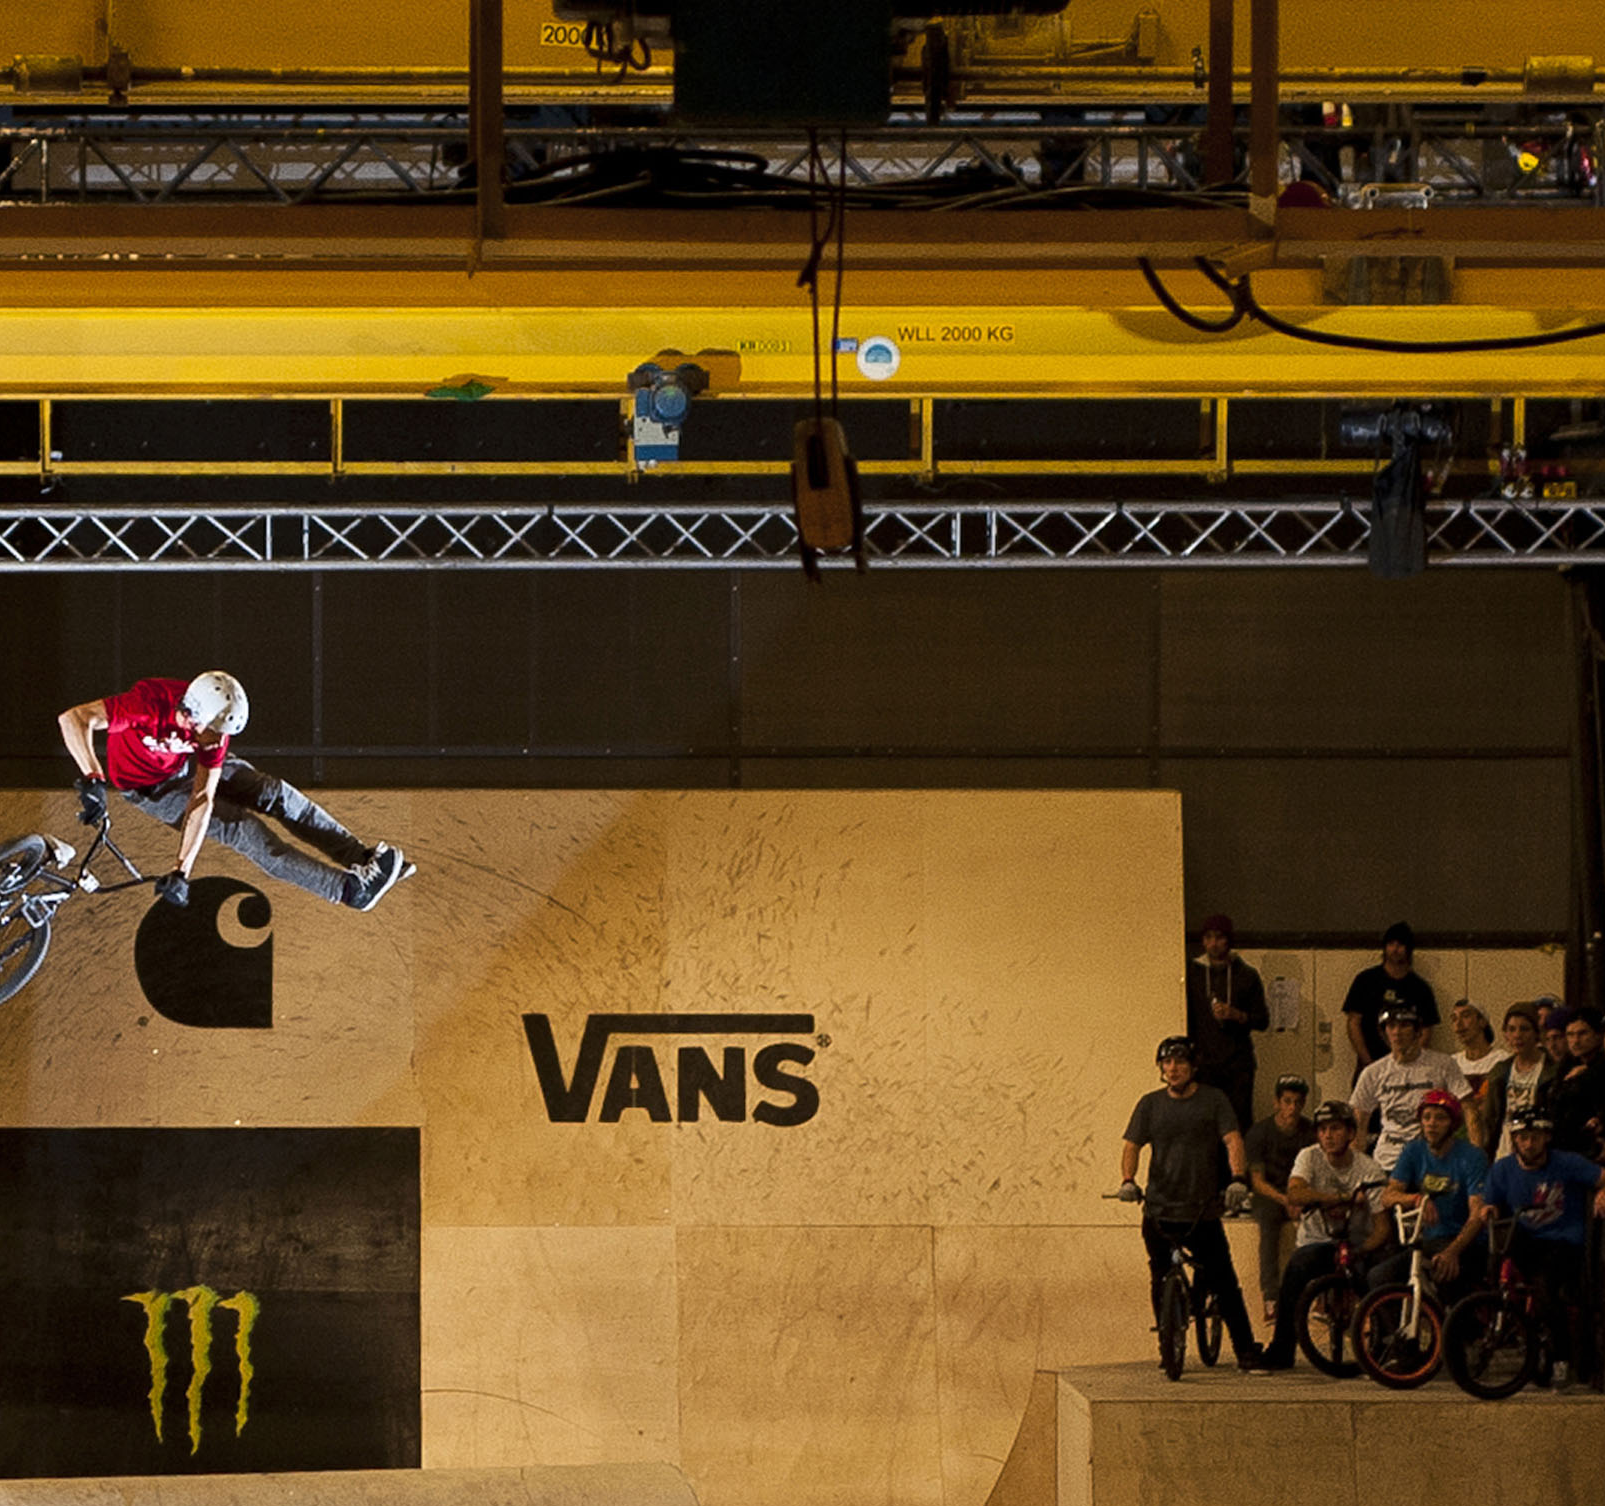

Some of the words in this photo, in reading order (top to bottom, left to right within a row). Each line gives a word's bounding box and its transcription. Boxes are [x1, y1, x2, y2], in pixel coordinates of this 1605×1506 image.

[897, 325, 936, 342] WLL
[940, 325, 983, 342] 2000
[986, 325, 1014, 342] KG
[521, 1013, 821, 1127] VANS
